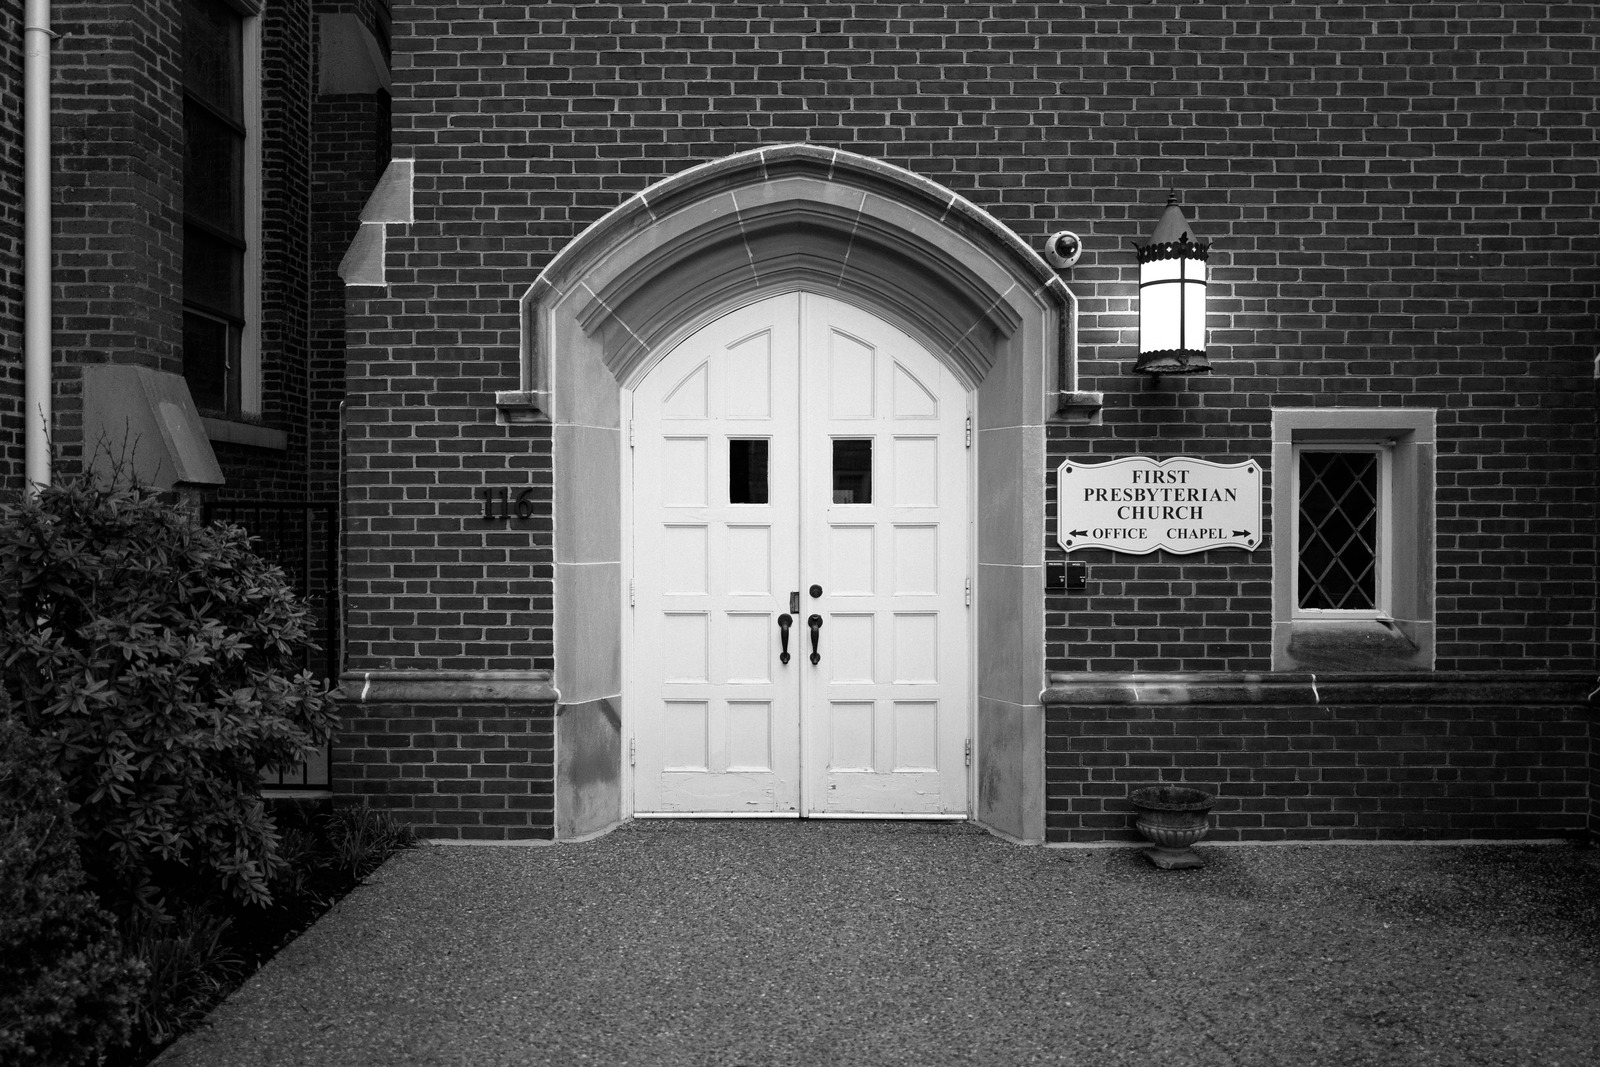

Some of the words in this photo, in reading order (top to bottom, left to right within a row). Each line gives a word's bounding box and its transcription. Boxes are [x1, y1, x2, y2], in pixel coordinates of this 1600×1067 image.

[1132, 470, 1190, 484] FIRST
[1084, 488, 1237, 502] PRESBYTERIAN
[483, 488, 534, 520] 116
[1117, 506, 1204, 520] CHURCH
[1092, 528, 1148, 539] OFFICE
[1166, 528, 1227, 539] CHAPEL
